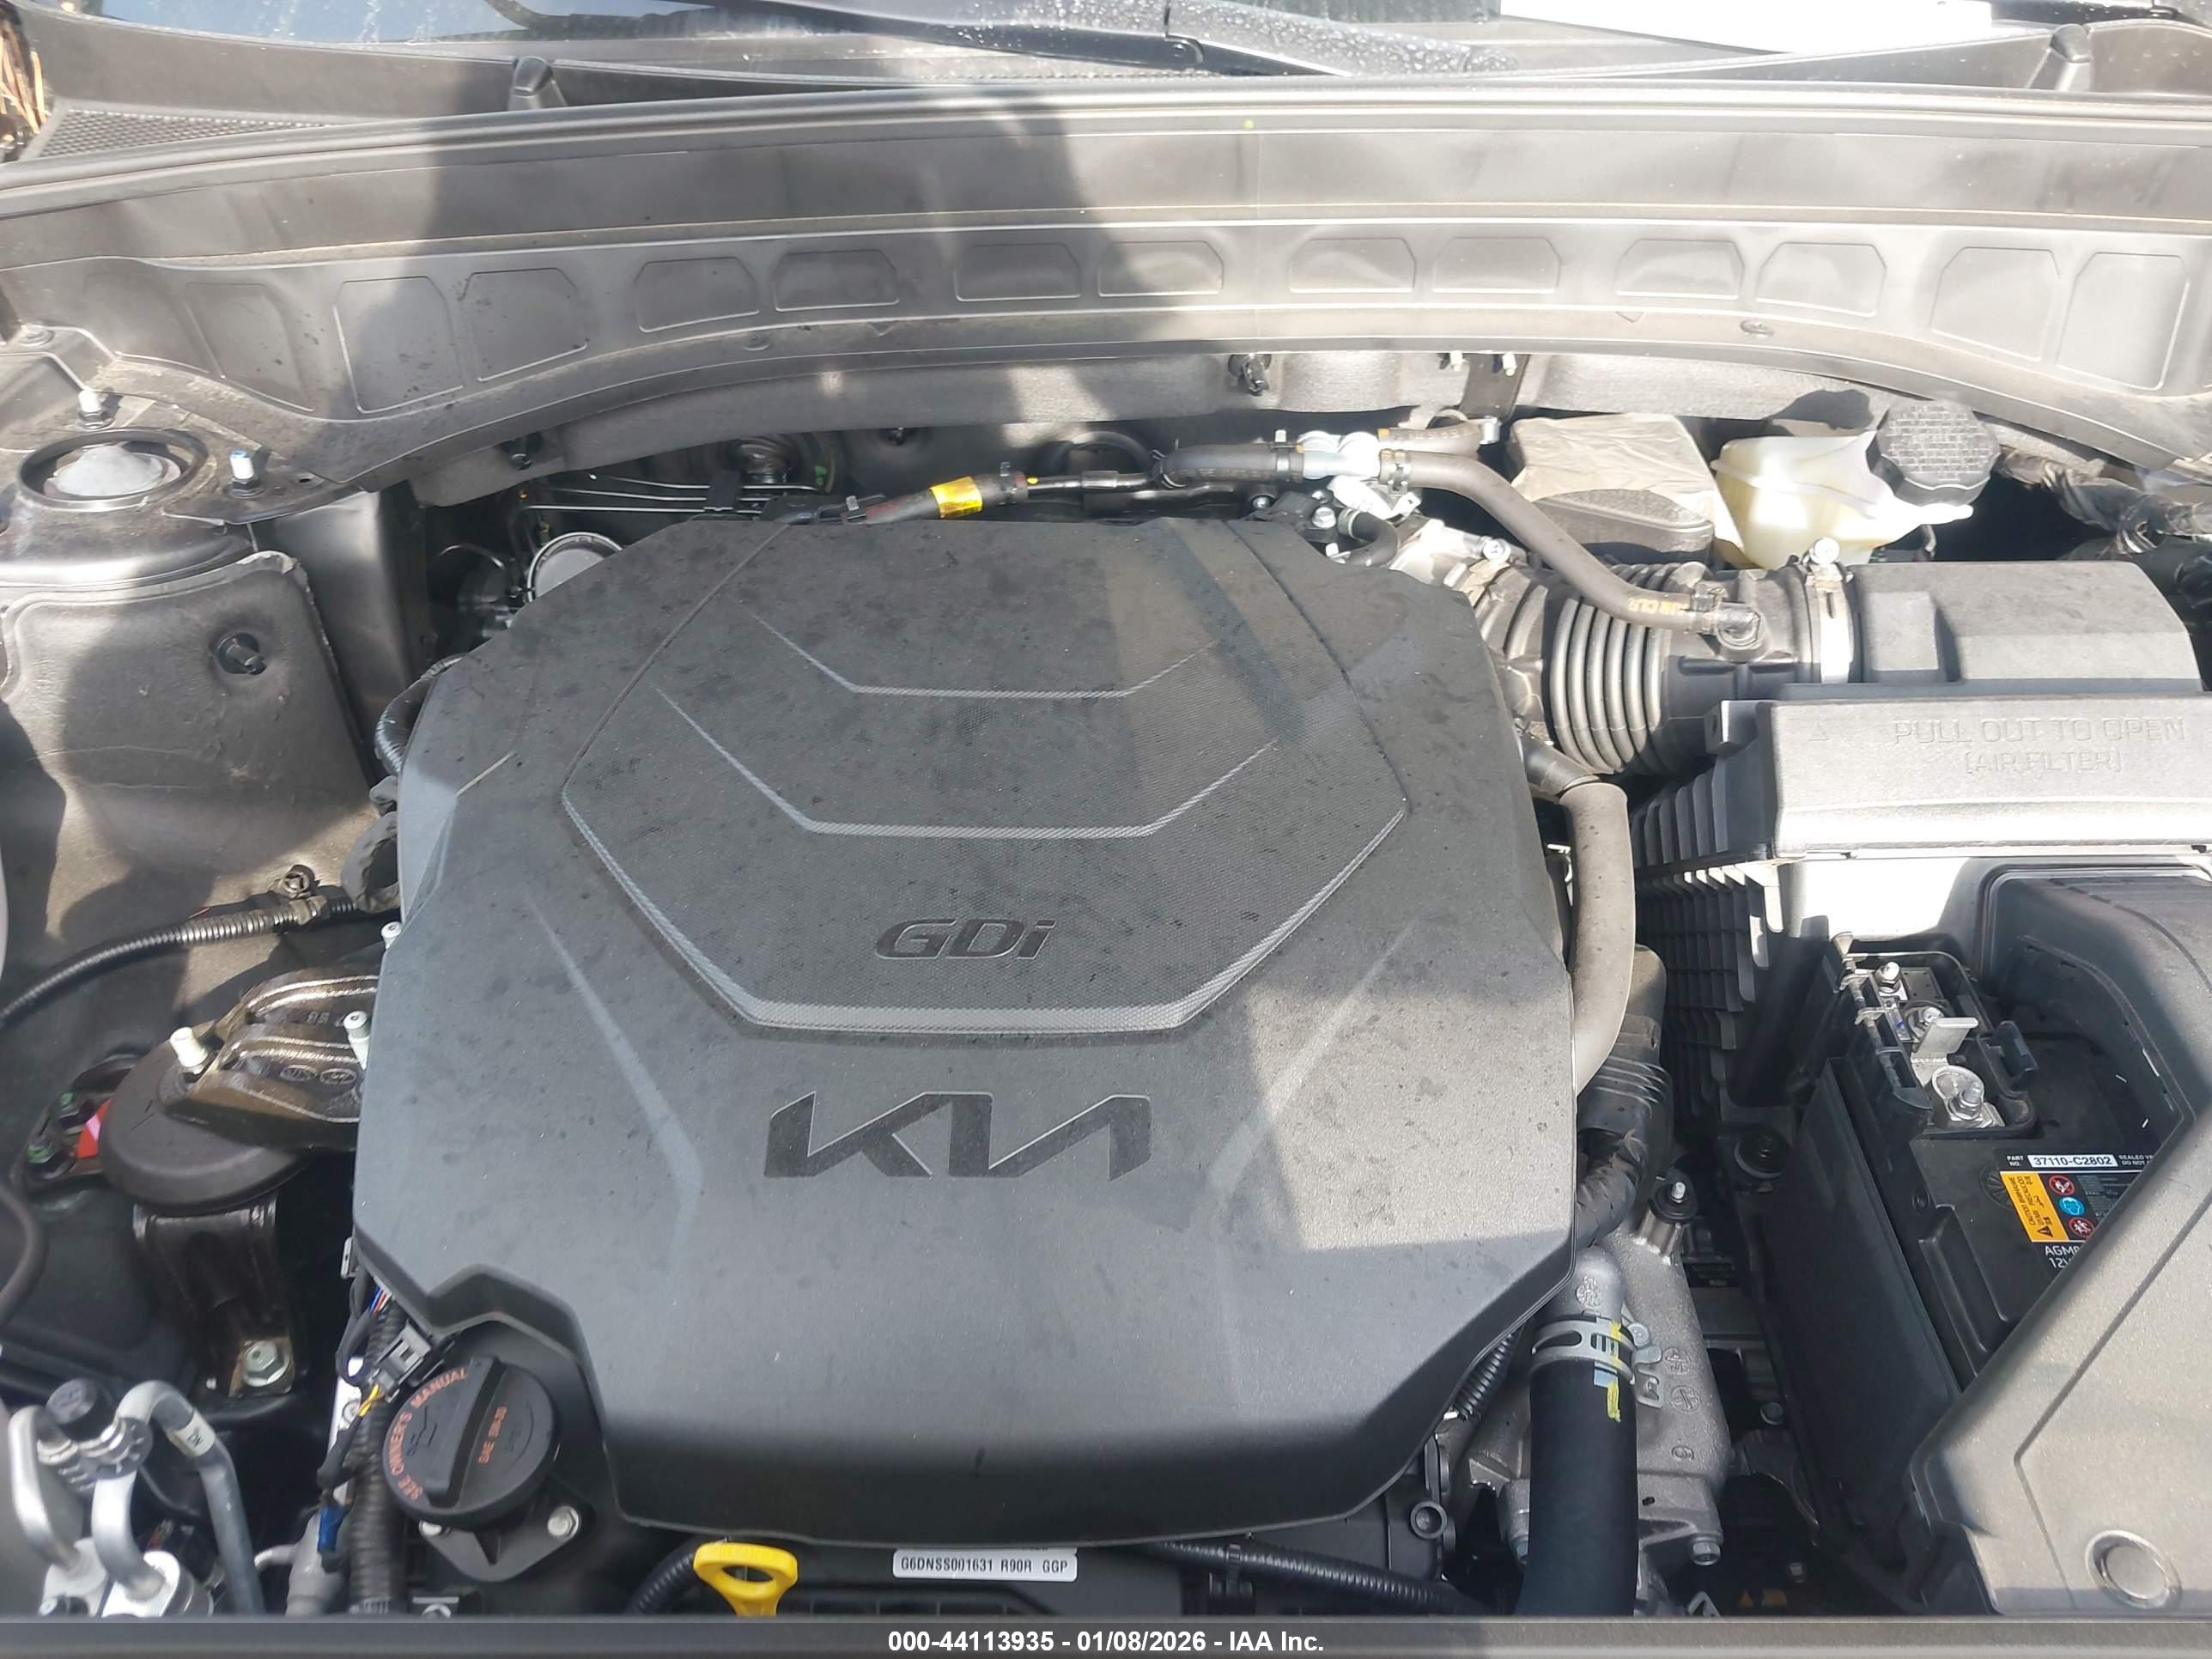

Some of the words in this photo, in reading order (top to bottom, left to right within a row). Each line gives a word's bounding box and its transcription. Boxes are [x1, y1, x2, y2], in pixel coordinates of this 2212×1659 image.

[1893, 720, 1972, 744] PULL
[1980, 719, 2041, 743] OUT
[2049, 718, 2093, 742] TO
[2102, 717, 2185, 742] OPEN
[874, 919, 1057, 960] GDi
[765, 1091, 1152, 1181] KIA
[2034, 1156, 2112, 1167] 37110-C2802
[398, 1476, 422, 1500] SEE
[410, 1367, 468, 1409] MANUAL
[1042, 1559, 1069, 1574] GGP
